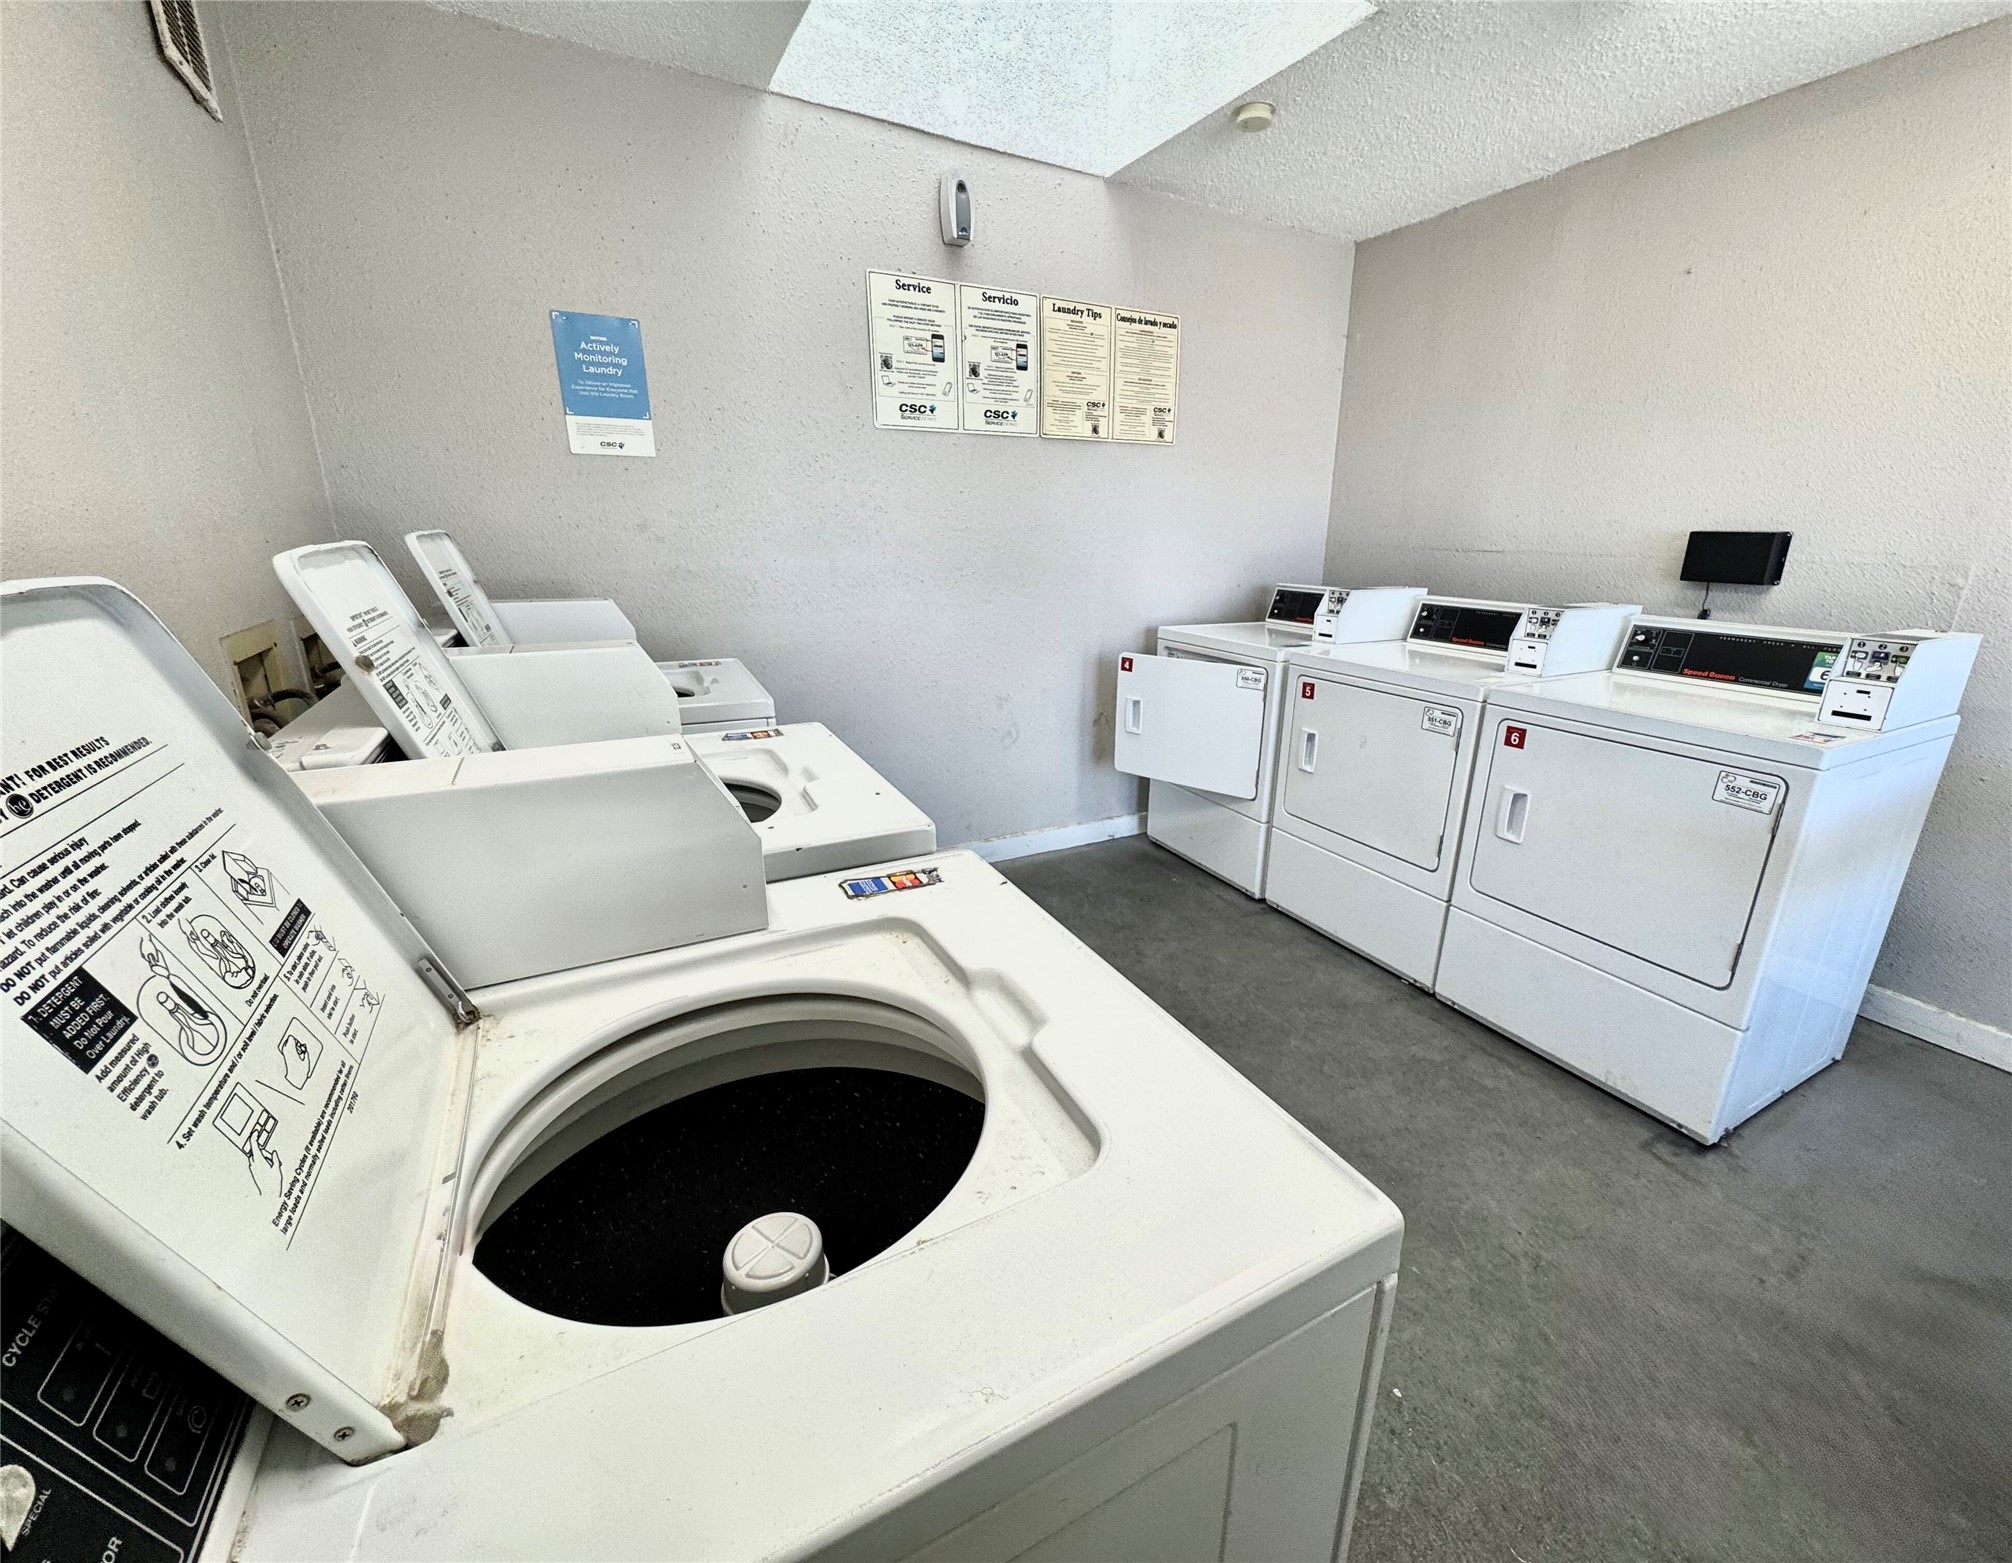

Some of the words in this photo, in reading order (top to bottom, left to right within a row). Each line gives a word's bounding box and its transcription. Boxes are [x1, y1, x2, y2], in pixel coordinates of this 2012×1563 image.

[895, 279, 932, 294] Service
[982, 292, 1018, 306] Servicio
[1052, 303, 1084, 318] Laundry
[1086, 308, 1102, 320] Tips
[1116, 313, 1137, 325] Consejos
[1138, 316, 1143, 324] de
[1144, 317, 1158, 326] lavado
[1159, 320, 1162, 329] y
[1162, 320, 1177, 329] secado
[574, 352, 628, 366] Monitoring
[580, 342, 619, 354] Actively
[582, 364, 622, 376] Laundry
[899, 403, 928, 414] CSC
[984, 409, 1010, 419] CSC
[1124, 661, 1129, 669] 4
[1682, 668, 1708, 678] Speed
[1709, 671, 1736, 680] Queen
[1738, 676, 1771, 686] Commercial
[1305, 686, 1310, 696] 5
[1511, 732, 1519, 744] 6
[24, 764, 50, 781] FOR
[45, 752, 73, 771] BEST
[69, 736, 109, 760] RESULTS
[28, 768, 88, 804] DETERGENT
[83, 764, 98, 775] IS
[93, 737, 152, 770] RECOMMENDED.
[1725, 785, 1767, 800] 552-CBG
[8, 899, 27, 912] into
[23, 891, 39, 902] the
[36, 876, 60, 894] washer
[58, 865, 74, 879] until
[71, 860, 81, 870] all
[78, 849, 102, 865] moving
[97, 840, 113, 854] parts
[108, 832, 124, 843] have
[121, 819, 141, 836] stopped.
[9, 875, 29, 888] Can
[26, 862, 49, 879] cause
[46, 848, 72, 866] serious
[67, 837, 89, 851] injury
[2, 928, 18, 940] let
[15, 910, 44, 932] children
[41, 900, 59, 914] play
[53, 895, 65, 903] in
[62, 889, 72, 898] or
[70, 883, 81, 892] on
[76, 876, 90, 886] the
[87, 863, 109, 879] washer.
[20, 939, 36, 949] To
[33, 921, 60, 942] reduce
[55, 912, 71, 923] the
[68, 902, 84, 915] risk
[80, 895, 90, 906] of
[86, 888, 102, 900] fire:
[148, 905, 162, 919] Load
[160, 894, 176, 909] clothes
[172, 882, 189, 896] loosely
[0, 977, 16, 993] DO
[13, 961, 36, 981] NOT
[34, 952, 50, 968] put
[45, 928, 80, 955] flammable
[76, 912, 101, 930] liquids,
[97, 894, 122, 914] cleaning
[118, 879, 141, 897] solvents,
[142, 862, 159, 877] articles
[13, 991, 31, 1006] DO
[28, 974, 50, 994] NOT
[48, 964, 63, 980] put
[60, 947, 85, 968] articles
[82, 930, 102, 949] soiled
[98, 922, 113, 934] with
[110, 903, 135, 924] vegetable
[132, 897, 140, 905] or
[138, 883, 159, 900] cooking
[37, 976, 82, 1013] DETERGENT
[49, 1006, 72, 1029] MUST
[70, 997, 84, 1010] BE
[62, 1013, 90, 1039] ADDED
[86, 994, 109, 1015] FIRST.
[73, 1037, 88, 1049] Do
[84, 1024, 100, 1039] Not
[95, 1010, 113, 1027] Pour
[86, 1041, 105, 1058] Over
[101, 1016, 130, 1043] Laundry.
[95, 1065, 112, 1083] Add
[108, 1033, 139, 1068] measured
[107, 1063, 133, 1093] amount
[129, 1055, 139, 1066] of
[134, 1042, 151, 1059] High
[116, 1066, 150, 1102] Efficiency
[130, 1076, 159, 1111] detergent
[154, 1070, 164, 1079] to
[175, 1140, 186, 1150] 4.
[182, 1127, 195, 1142] Set
[192, 1109, 207, 1128] wash
[203, 1072, 230, 1110] temperature
[227, 1059, 238, 1074] and
[236, 1051, 243, 1059] or
[241, 1040, 250, 1053] soil
[246, 1028, 257, 1043] level
[140, 1100, 158, 1120] wash
[154, 1088, 169, 1102] tub.
[280, 1215, 293, 1235] large
[289, 1194, 302, 1215] loads
[299, 1179, 307, 1195] and
[304, 1152, 320, 1181] normally
[316, 1133, 326, 1153] soiled
[322, 1119, 332, 1135] loads
[329, 1094, 343, 1119] including
[2, 1314, 41, 1366] CYCLE
[22, 1488, 52, 1536] SPECIAL
[100, 1536, 122, 1563] OR
